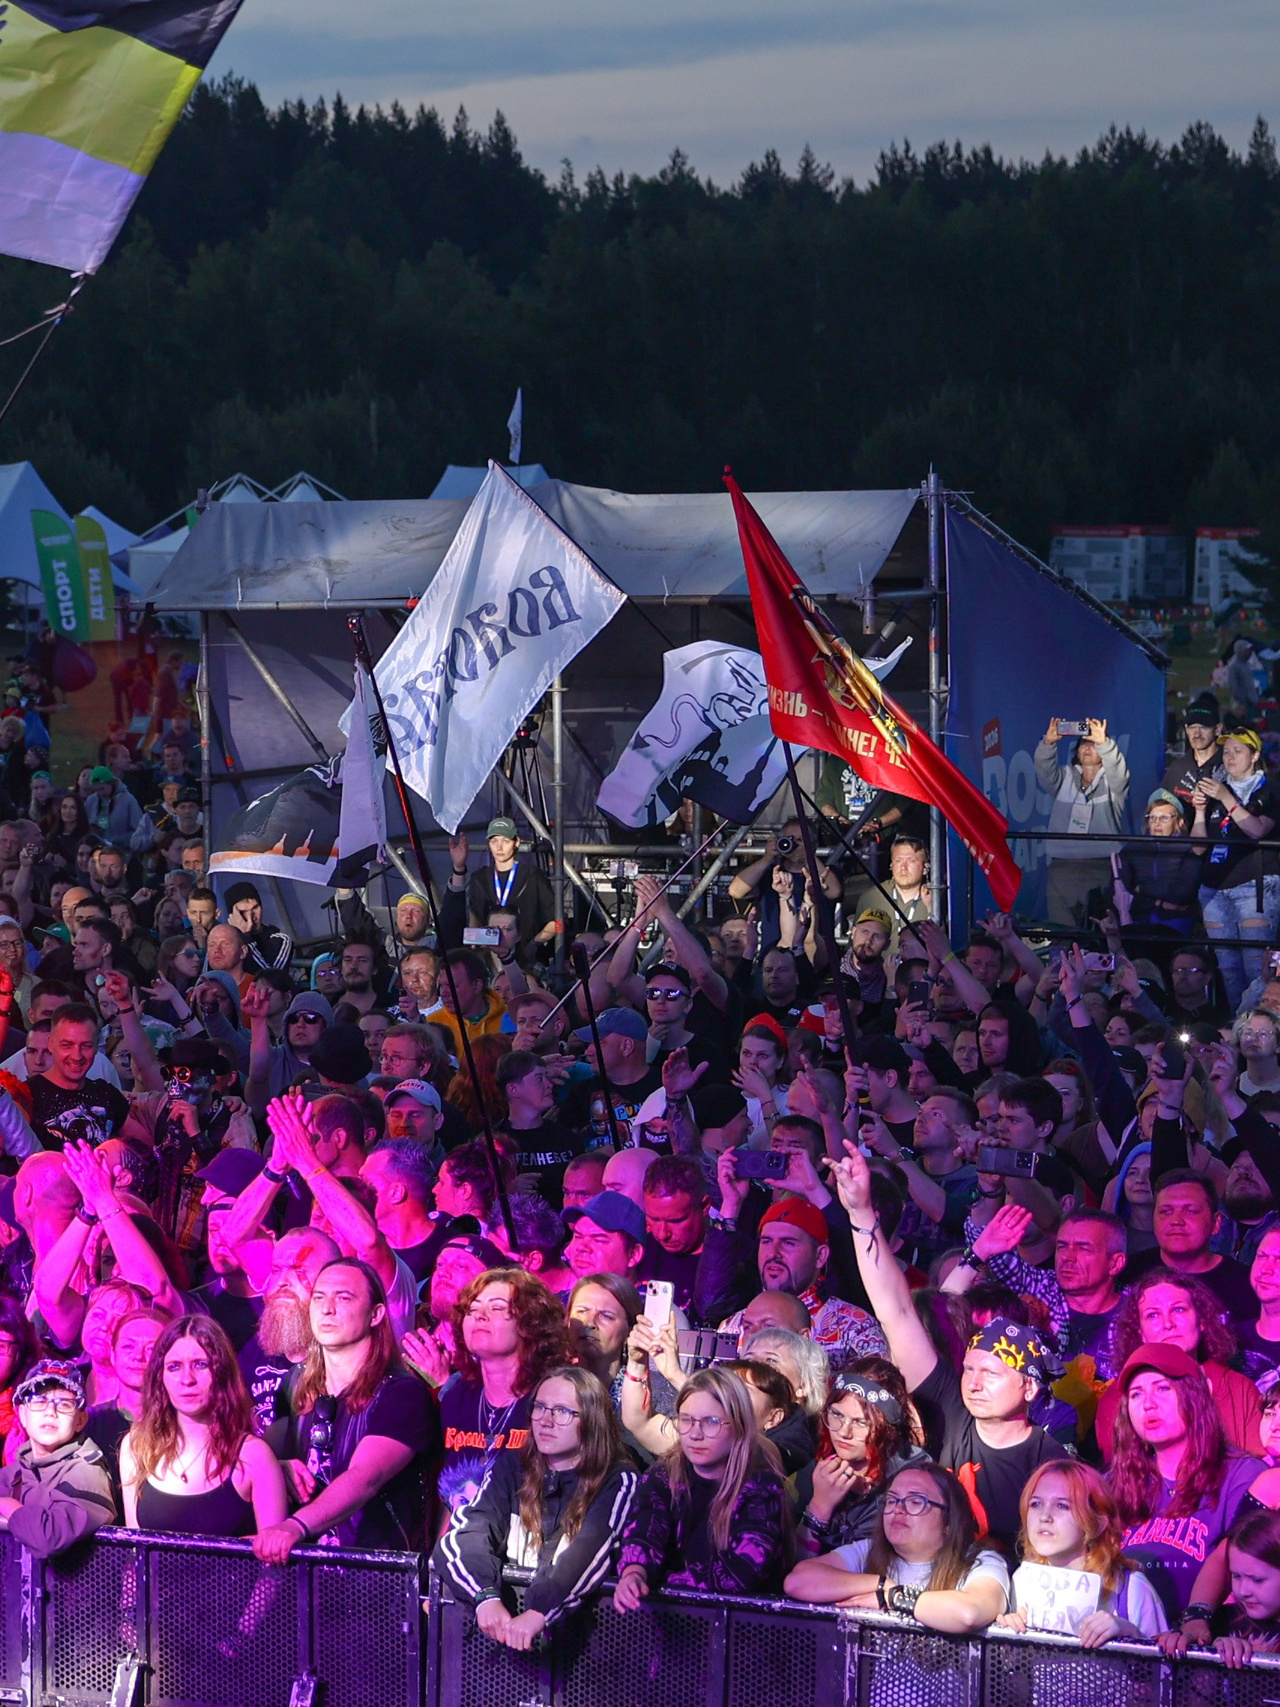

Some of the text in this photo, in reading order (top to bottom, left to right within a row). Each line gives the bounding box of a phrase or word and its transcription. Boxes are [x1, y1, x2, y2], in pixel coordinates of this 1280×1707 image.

[51, 558, 78, 632] СПОРТ
[88, 567, 107, 622] ДЕТИ
[767, 684, 808, 718] ИЗНЬ
[615, 1102, 644, 1121] PUN
